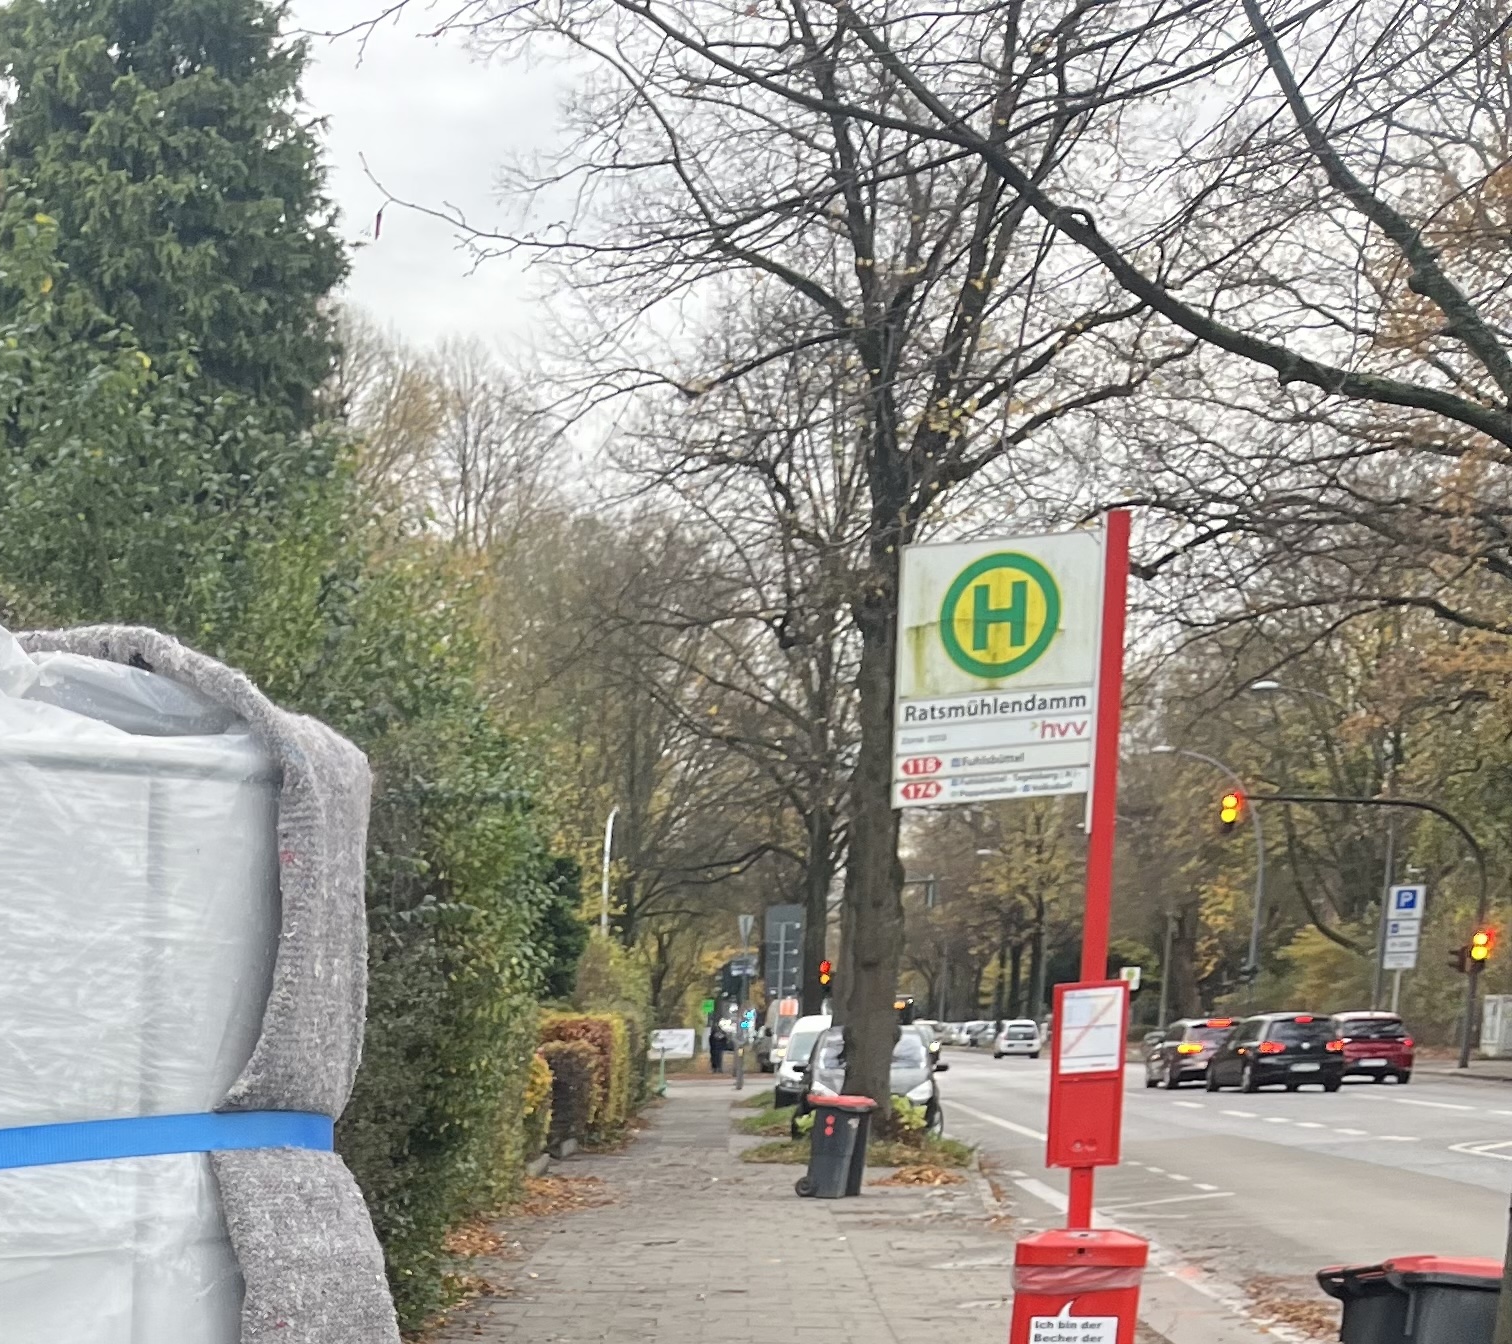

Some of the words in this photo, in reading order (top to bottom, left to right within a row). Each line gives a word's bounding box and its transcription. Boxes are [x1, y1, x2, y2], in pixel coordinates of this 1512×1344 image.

[973, 580, 1028, 651] H
[904, 694, 1087, 722] Ratsmühlendamm
[1040, 720, 1088, 739] hvv
[906, 757, 937, 775] 118
[906, 782, 937, 799] 174
[1035, 1321, 1054, 1329] Ich
[1058, 1321, 1077, 1329] bin
[1081, 1321, 1102, 1329] der
[1034, 1334, 1078, 1342] Becher
[1081, 1334, 1104, 1342] der
